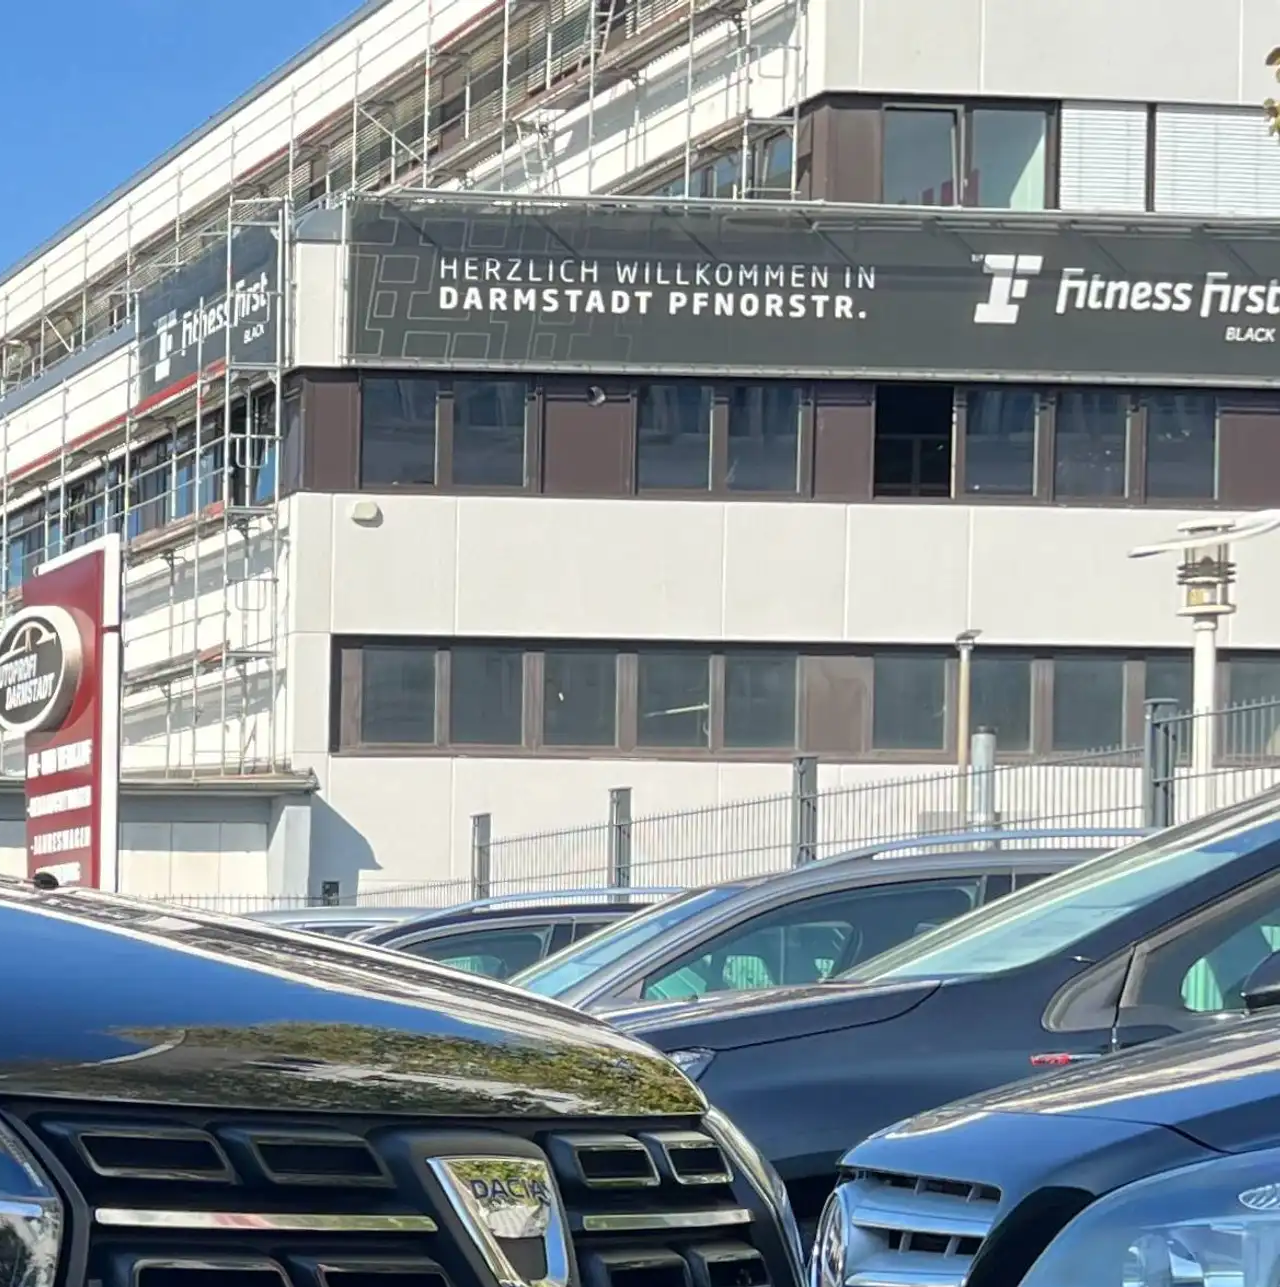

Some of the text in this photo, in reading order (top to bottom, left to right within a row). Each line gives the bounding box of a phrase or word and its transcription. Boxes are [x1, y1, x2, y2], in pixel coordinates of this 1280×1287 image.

[440, 257, 876, 290] HERZLICH WILLKOMMEN IN
[439, 286, 868, 319] DARMSTADT PFNORSTR.
[1055, 268, 1193, 315] Fitness
[243, 323, 265, 344] BLACK
[1224, 326, 1277, 343] BLACK
[470, 1176, 551, 1207] DACIA
